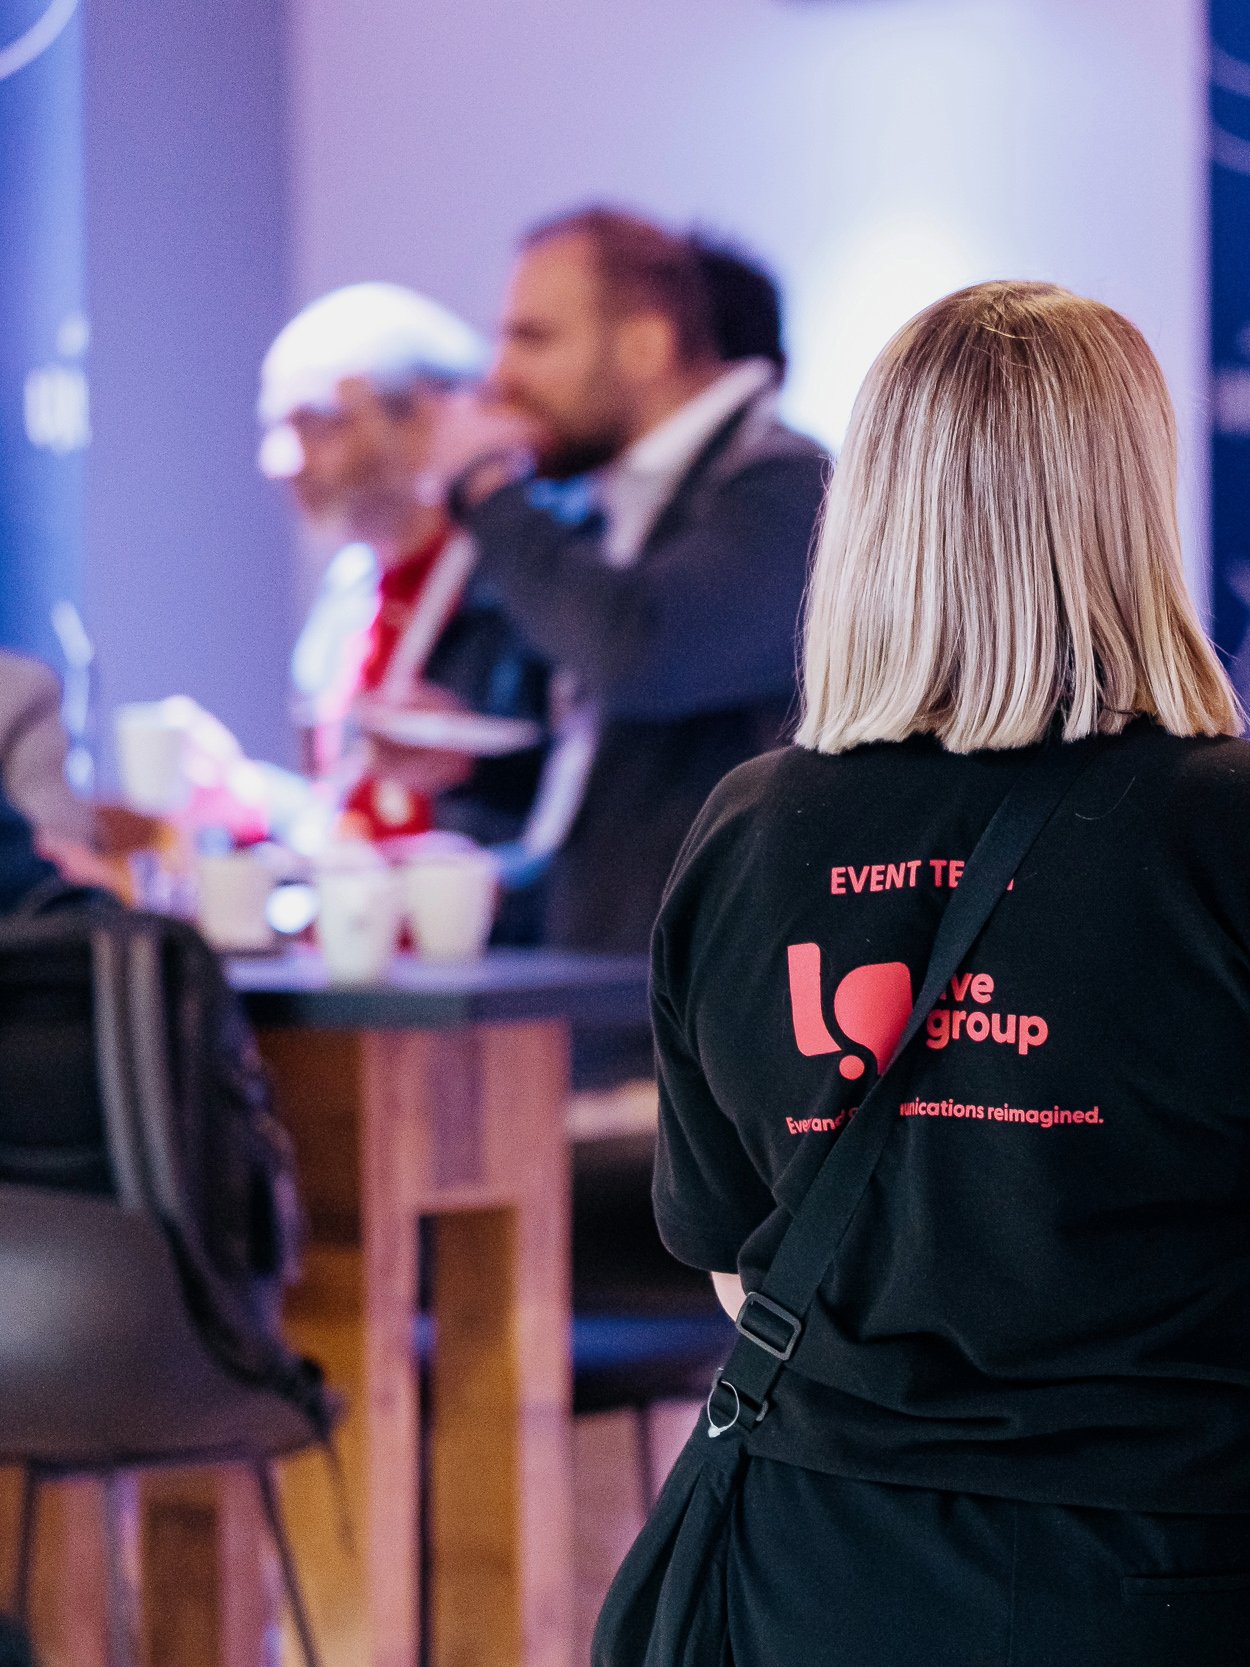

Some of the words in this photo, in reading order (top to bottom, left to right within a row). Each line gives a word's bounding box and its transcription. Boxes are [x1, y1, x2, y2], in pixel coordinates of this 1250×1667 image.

[830, 860, 922, 895] EVENT
[926, 1008, 1049, 1056] group
[987, 1102, 1105, 1129] reimagined.
